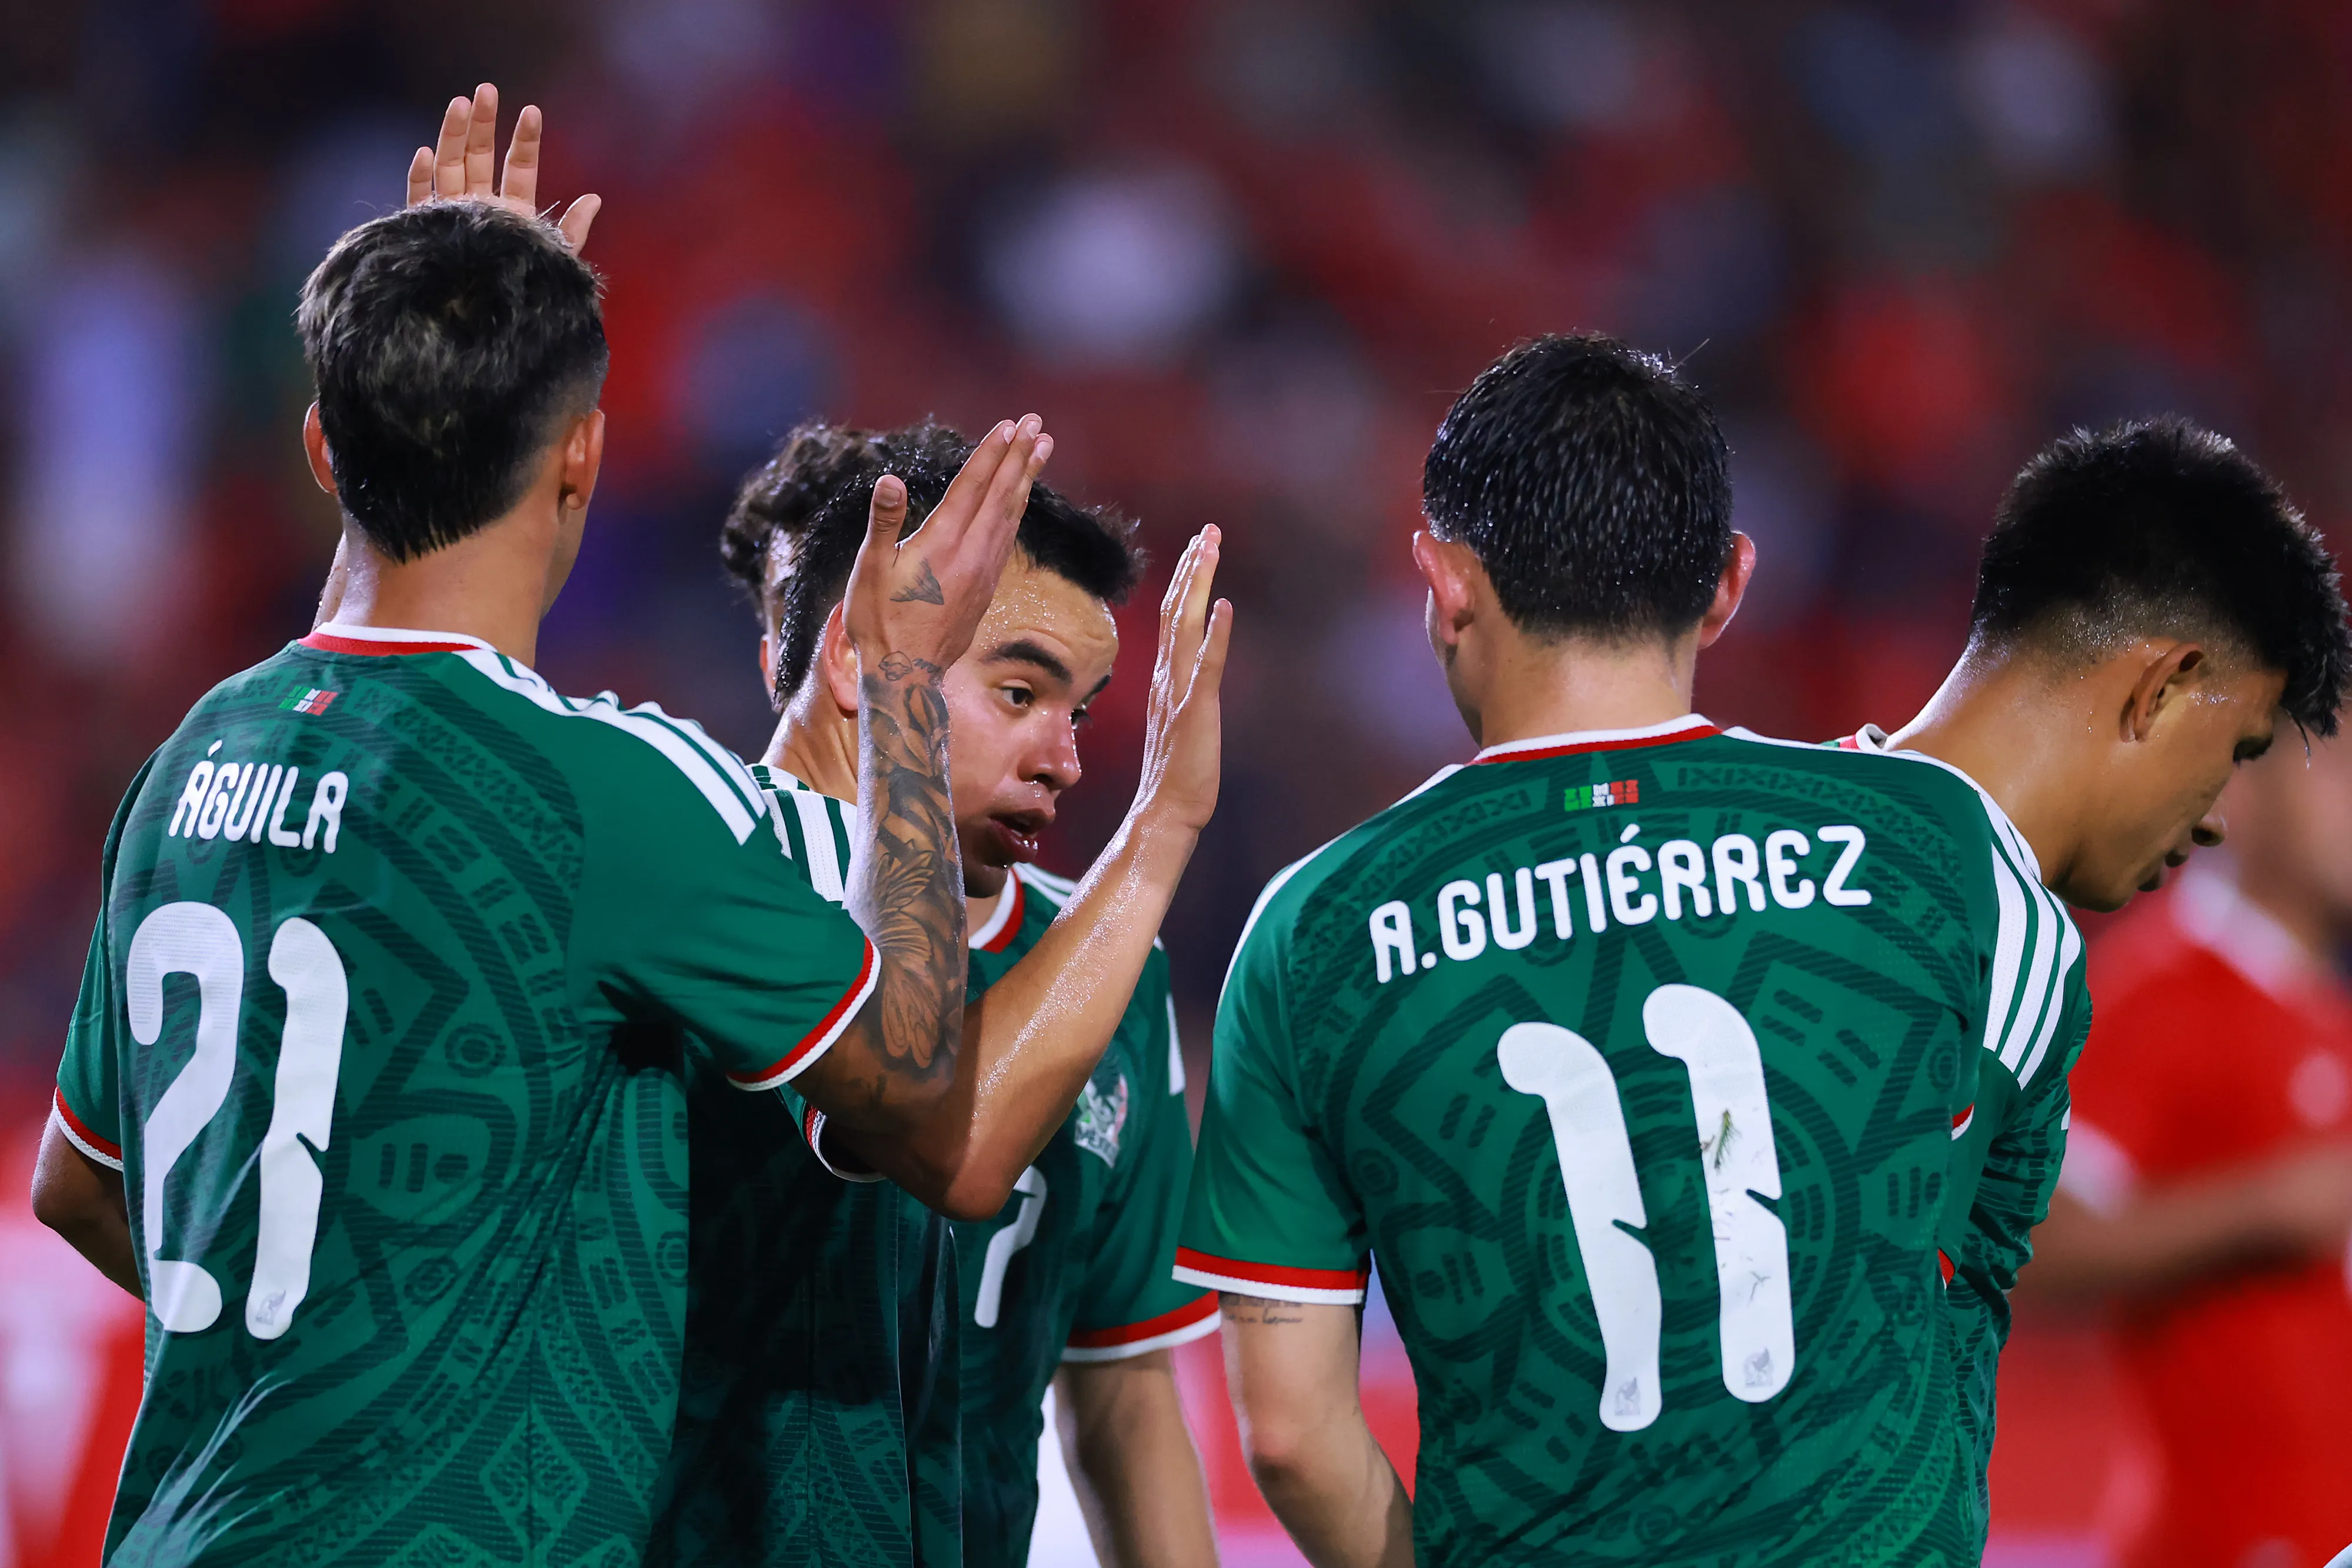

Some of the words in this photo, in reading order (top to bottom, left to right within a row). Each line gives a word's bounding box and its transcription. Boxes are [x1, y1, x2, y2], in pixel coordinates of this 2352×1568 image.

[168, 739, 349, 854] ÁGUILA
[1368, 823, 1873, 984] A.GUTIÉRREZ
[126, 901, 349, 1340] 21
[1496, 984, 1796, 1432] 11
